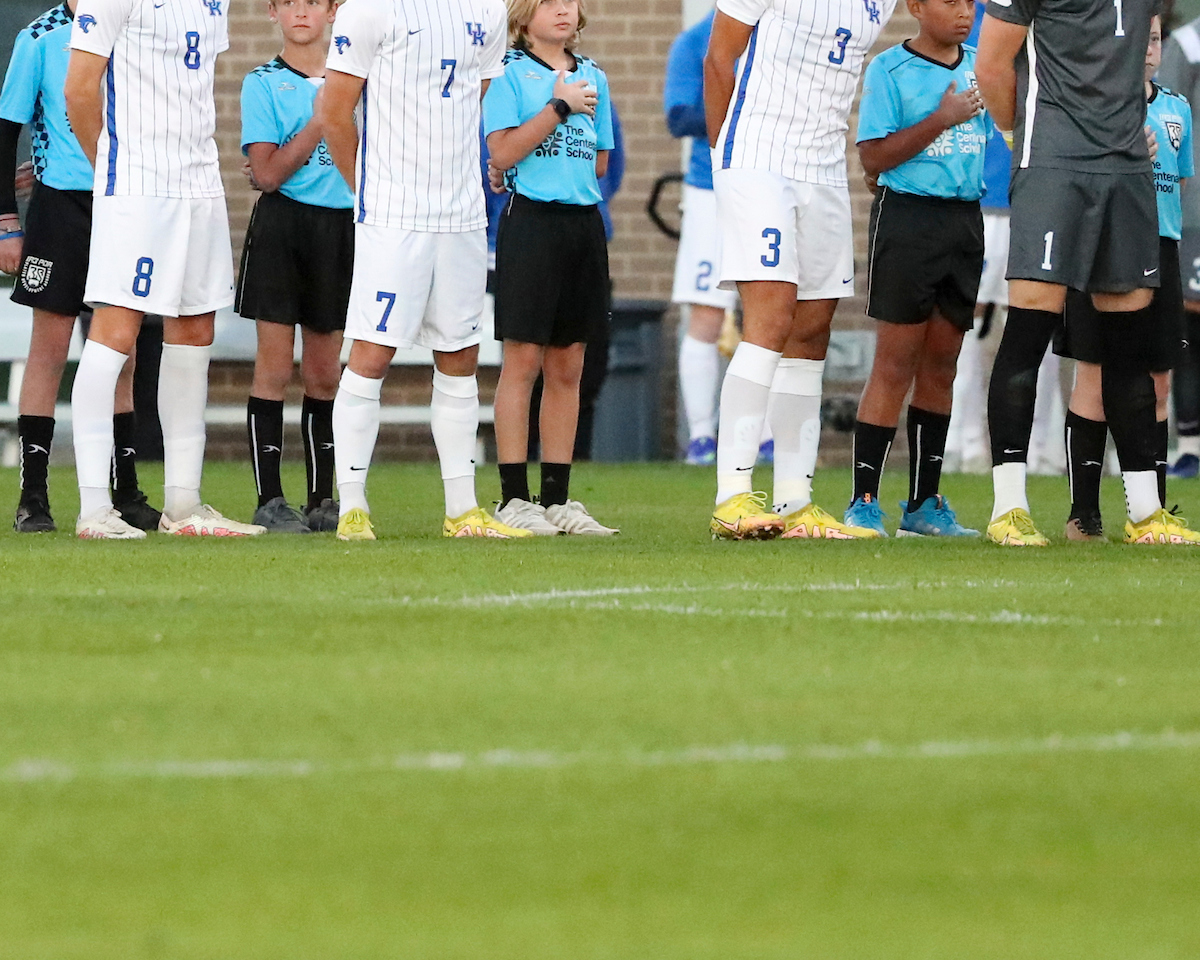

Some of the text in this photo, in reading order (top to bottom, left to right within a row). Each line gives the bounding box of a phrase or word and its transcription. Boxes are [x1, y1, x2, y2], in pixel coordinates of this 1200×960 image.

[184, 31, 200, 70] 8
[465, 22, 486, 45] UK
[828, 27, 852, 65] 3
[440, 59, 457, 98] 7
[564, 124, 584, 137] The
[760, 227, 782, 268] 3
[1041, 230, 1054, 271] 1
[131, 256, 154, 298] 8
[695, 260, 713, 292] 2
[376, 290, 397, 333] 7
